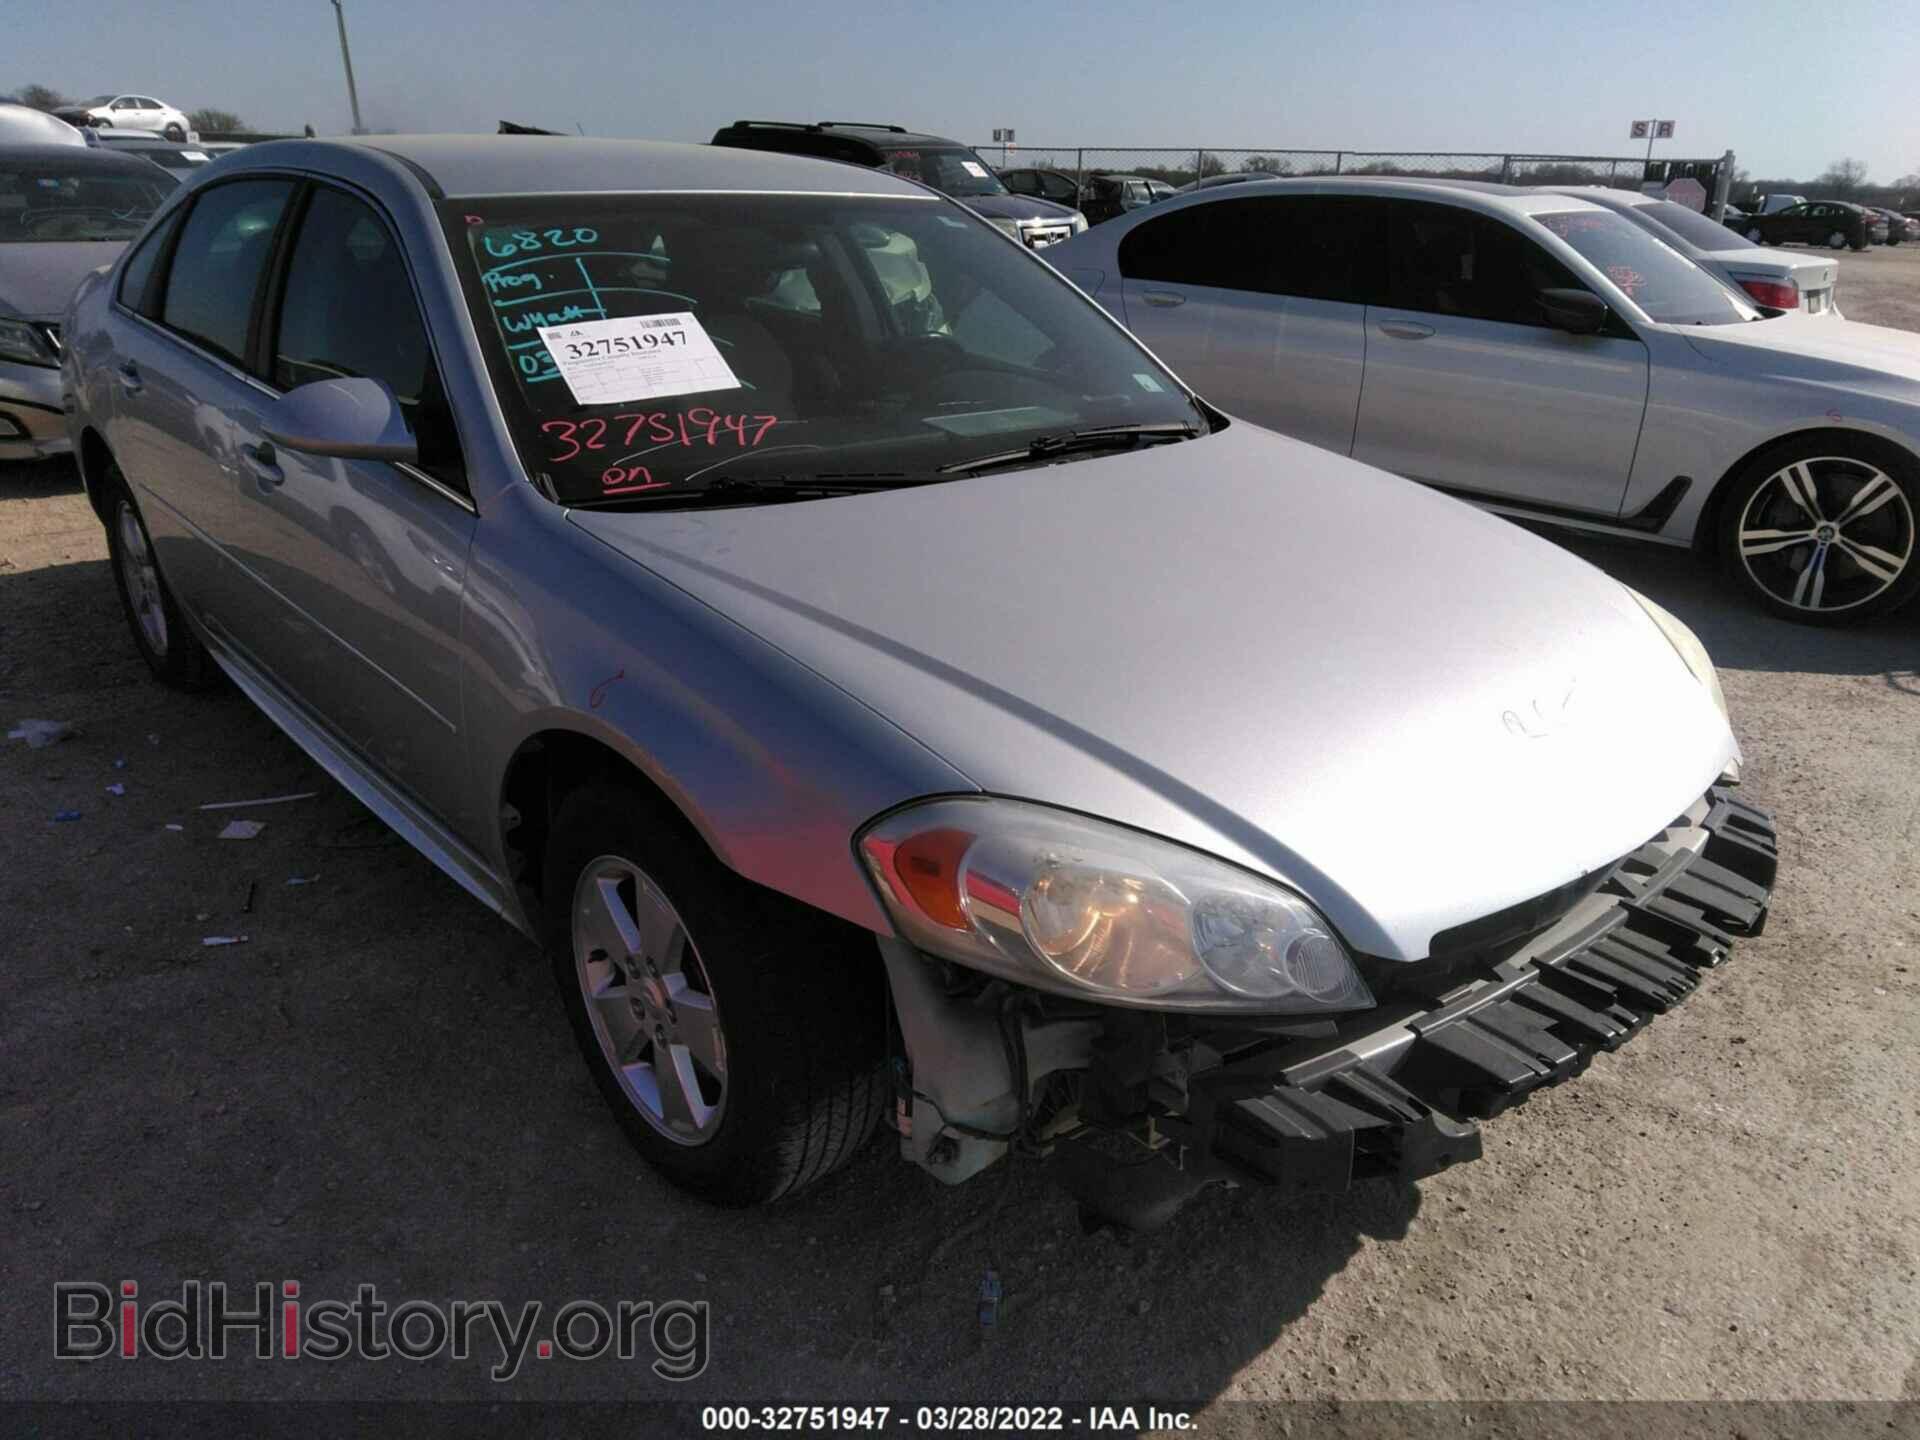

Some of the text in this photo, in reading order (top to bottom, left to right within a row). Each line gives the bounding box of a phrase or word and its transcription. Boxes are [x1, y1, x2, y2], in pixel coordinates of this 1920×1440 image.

[1632, 122, 1672, 137] S R
[484, 227, 598, 256] 6820
[565, 330, 688, 360] 32751947
[540, 408, 777, 462] 32751947
